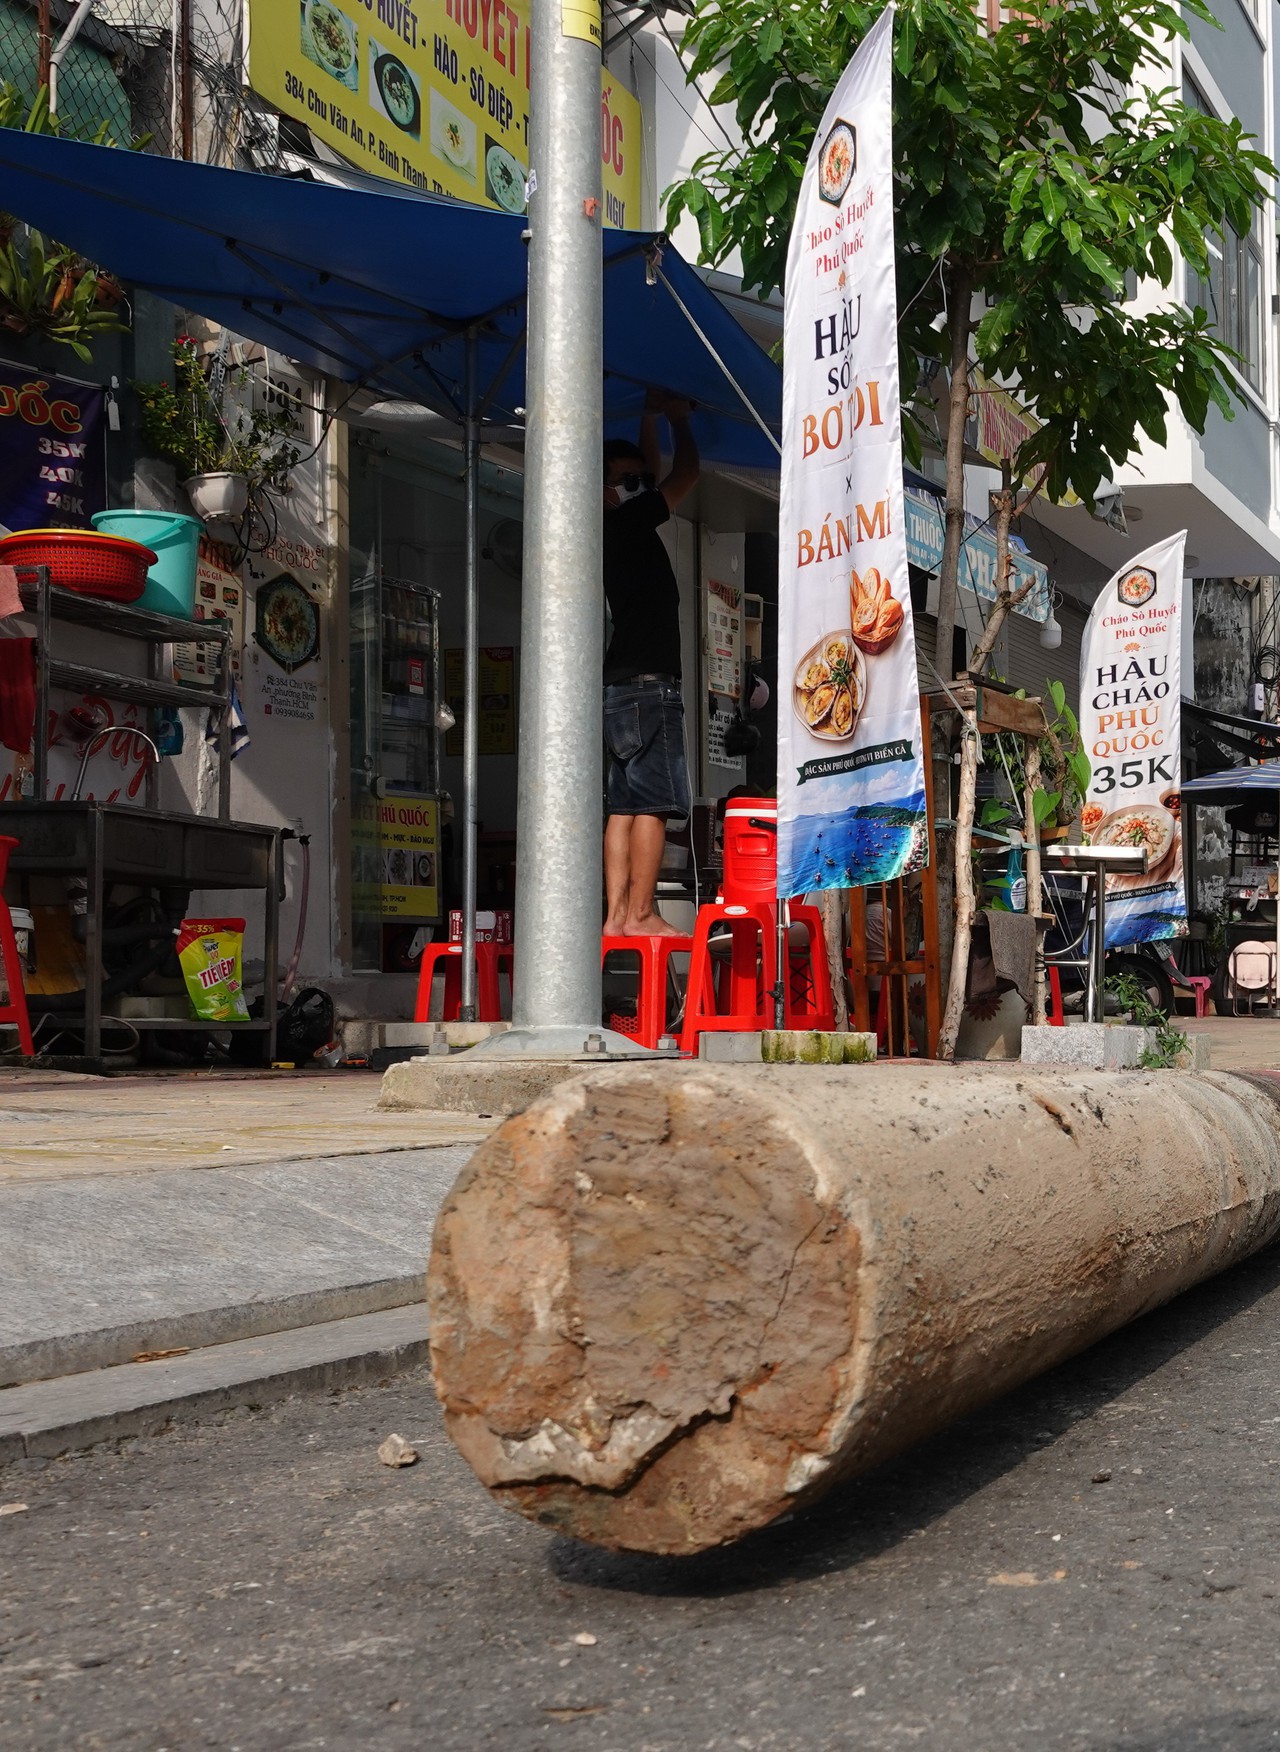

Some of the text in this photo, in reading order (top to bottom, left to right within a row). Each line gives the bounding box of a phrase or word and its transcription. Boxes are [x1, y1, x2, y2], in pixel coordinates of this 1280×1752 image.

[434, 33, 458, 85] HÀO
[469, 65, 485, 109] SÒ
[488, 82, 513, 134] ĐIỆP
[284, 70, 305, 104] 384
[307, 88, 327, 121] Chu
[330, 103, 348, 135] Văn
[368, 131, 377, 156] P.
[834, 212, 846, 236] Sò
[816, 228, 864, 277] Phú Quốc
[814, 293, 862, 361] HÀU
[802, 400, 844, 460] BƠ
[38, 437, 87, 460] 35K
[39, 465, 84, 488] 40K
[46, 491, 85, 516] 45K
[909, 512, 943, 553] THUỐC
[1102, 603, 1177, 628] Cháo Sò Huyết
[1115, 621, 1167, 640] Phú Quốc
[1096, 656, 1168, 687] HÀU
[1092, 681, 1170, 710] CHÁO
[1098, 702, 1160, 735] PHÚ
[895, 743, 907, 755] CẢ
[1092, 726, 1164, 758] QUỐC
[1092, 754, 1173, 794] 35K
[399, 805, 430, 828] QUỐC
